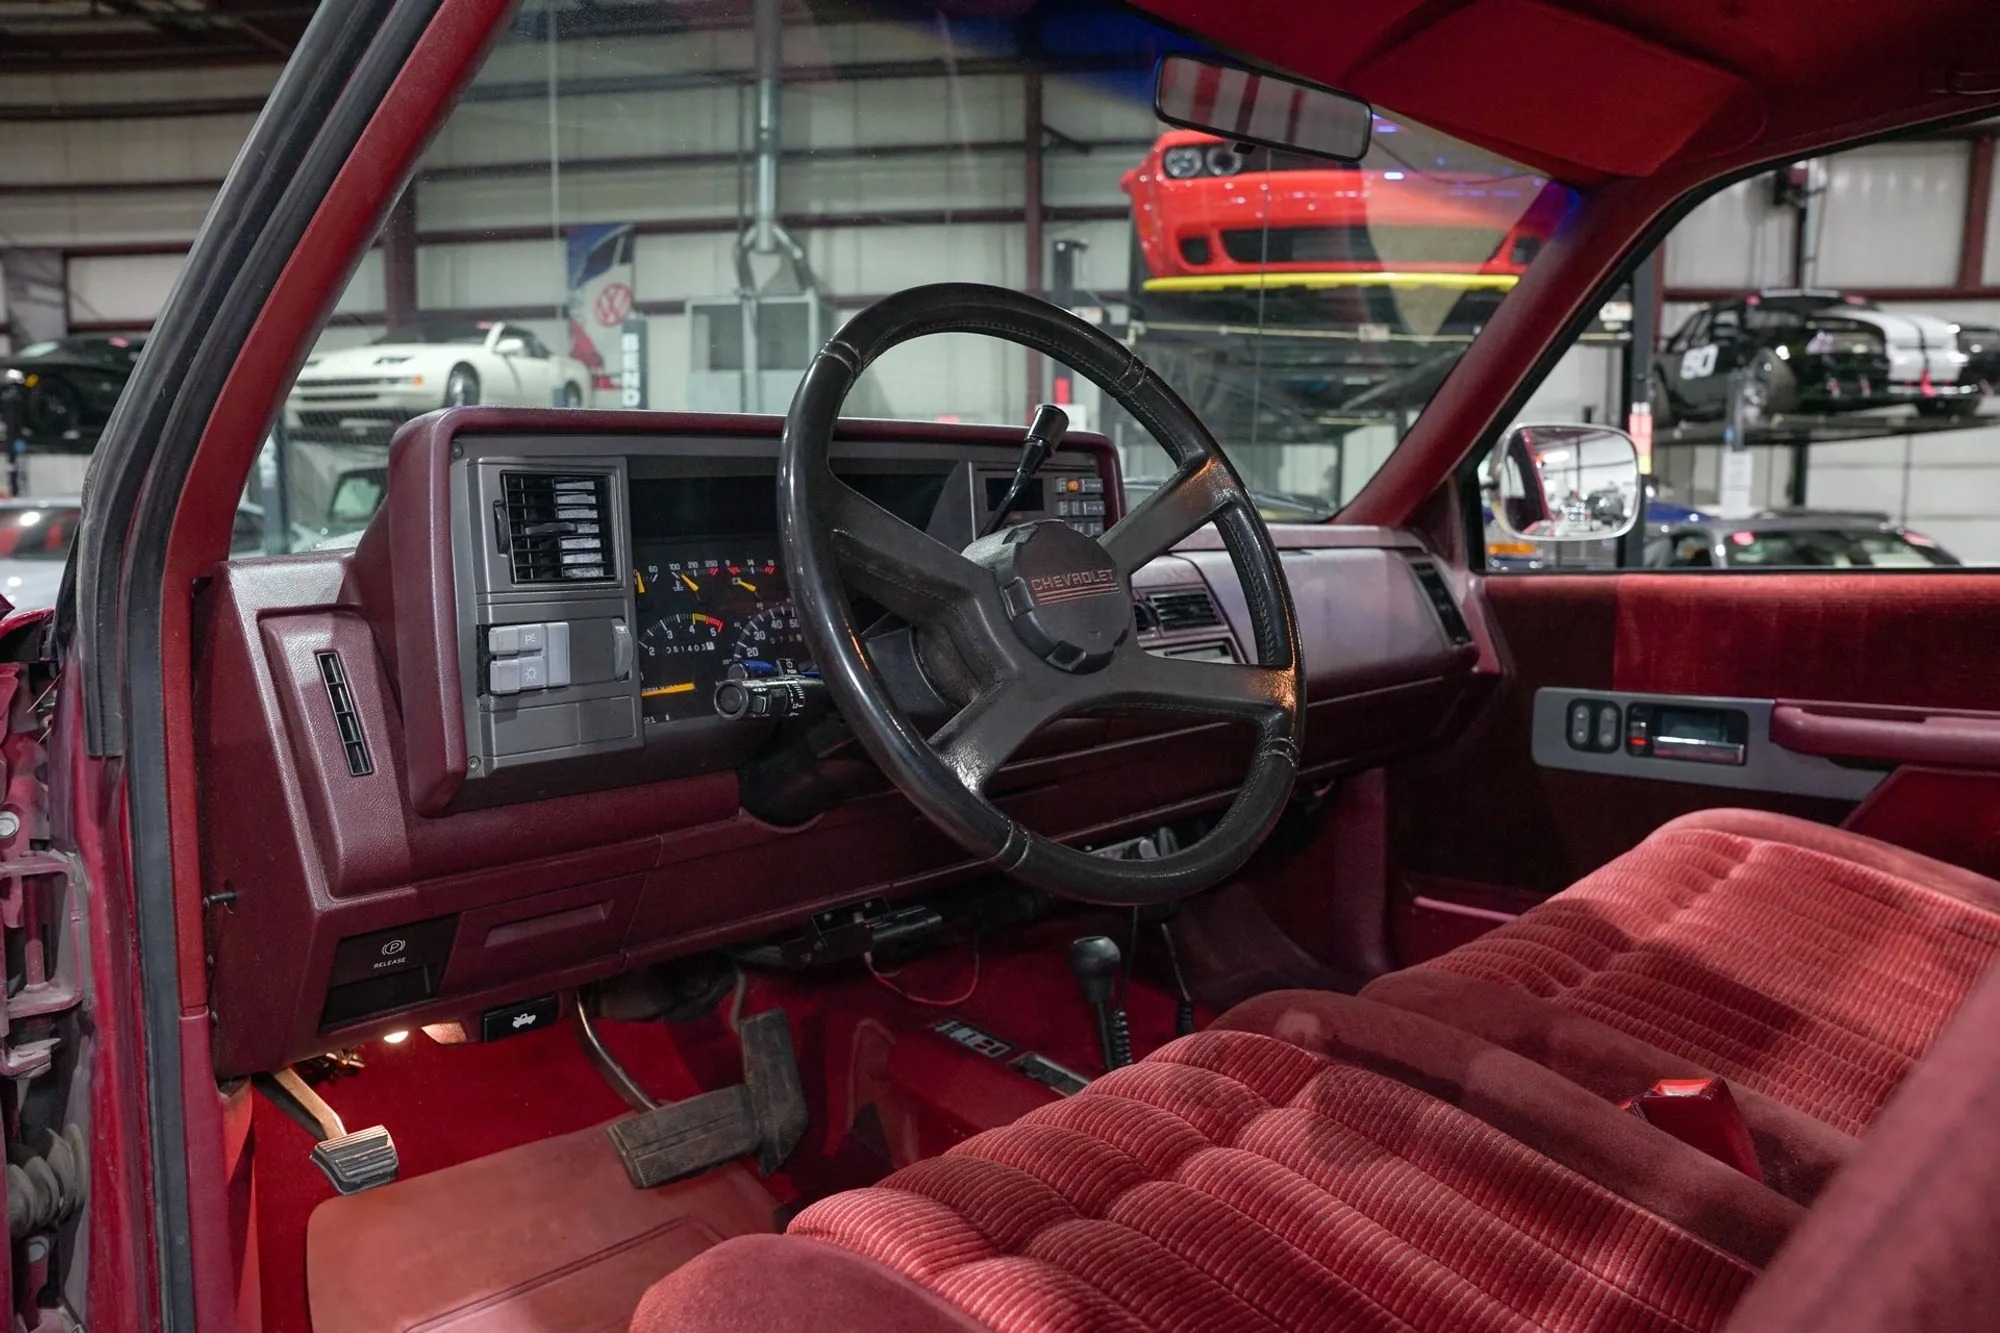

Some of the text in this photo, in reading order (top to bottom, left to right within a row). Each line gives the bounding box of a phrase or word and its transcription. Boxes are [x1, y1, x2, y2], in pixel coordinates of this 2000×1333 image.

[648, 565, 659, 573] 60
[669, 563, 681, 571] 100
[687, 561, 699, 569] 210
[1031, 569, 1113, 591] CHEVROLET
[689, 624, 696, 634] 4
[771, 619, 783, 629] 40
[666, 630, 674, 640] 3
[709, 627, 717, 637] 5
[753, 630, 766, 640] 30
[648, 646, 656, 656] 2
[746, 647, 759, 657] 20
[373, 957, 407, 969] RELEASE
